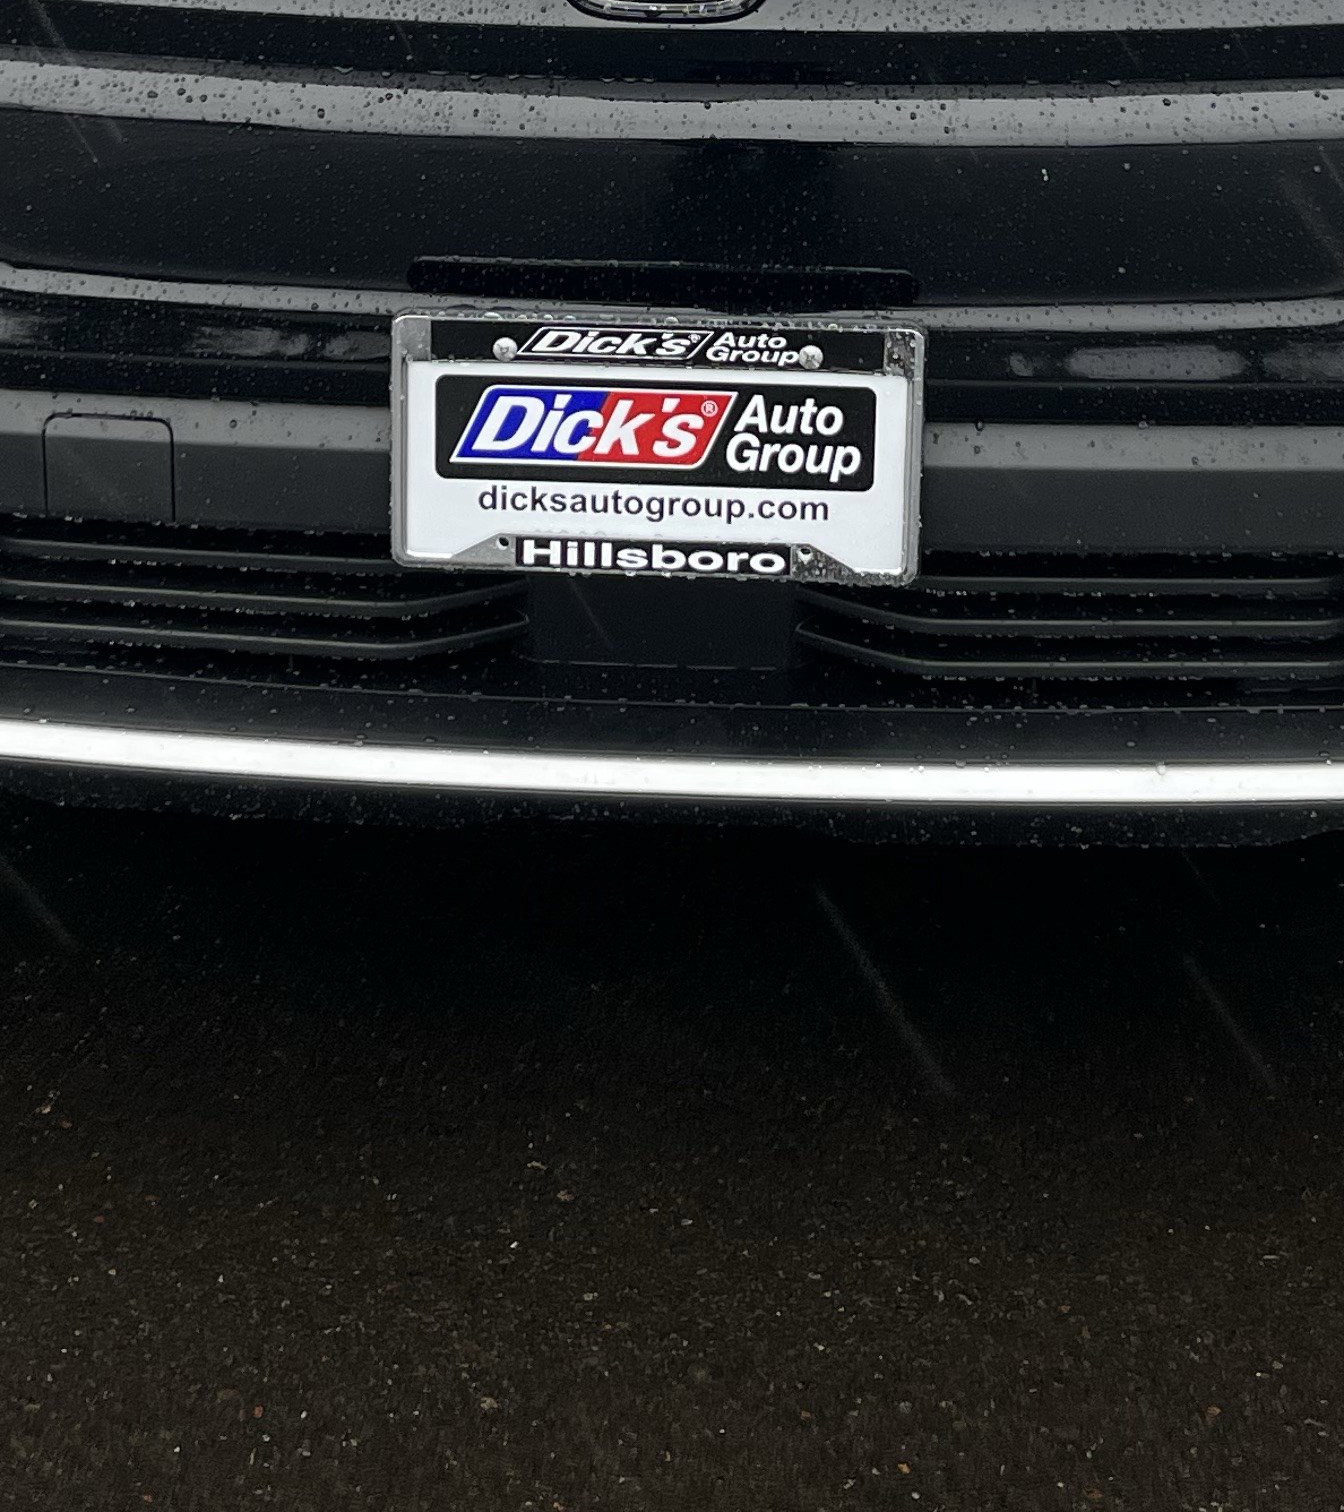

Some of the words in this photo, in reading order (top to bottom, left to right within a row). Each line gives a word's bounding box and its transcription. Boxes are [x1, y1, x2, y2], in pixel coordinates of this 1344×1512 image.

[705, 344, 800, 367] Group
[713, 331, 788, 349] Auto
[733, 394, 844, 437] Auto
[725, 434, 862, 483] Group
[478, 485, 829, 524] dicksautogroup.com
[521, 539, 787, 573] Hillsboro
